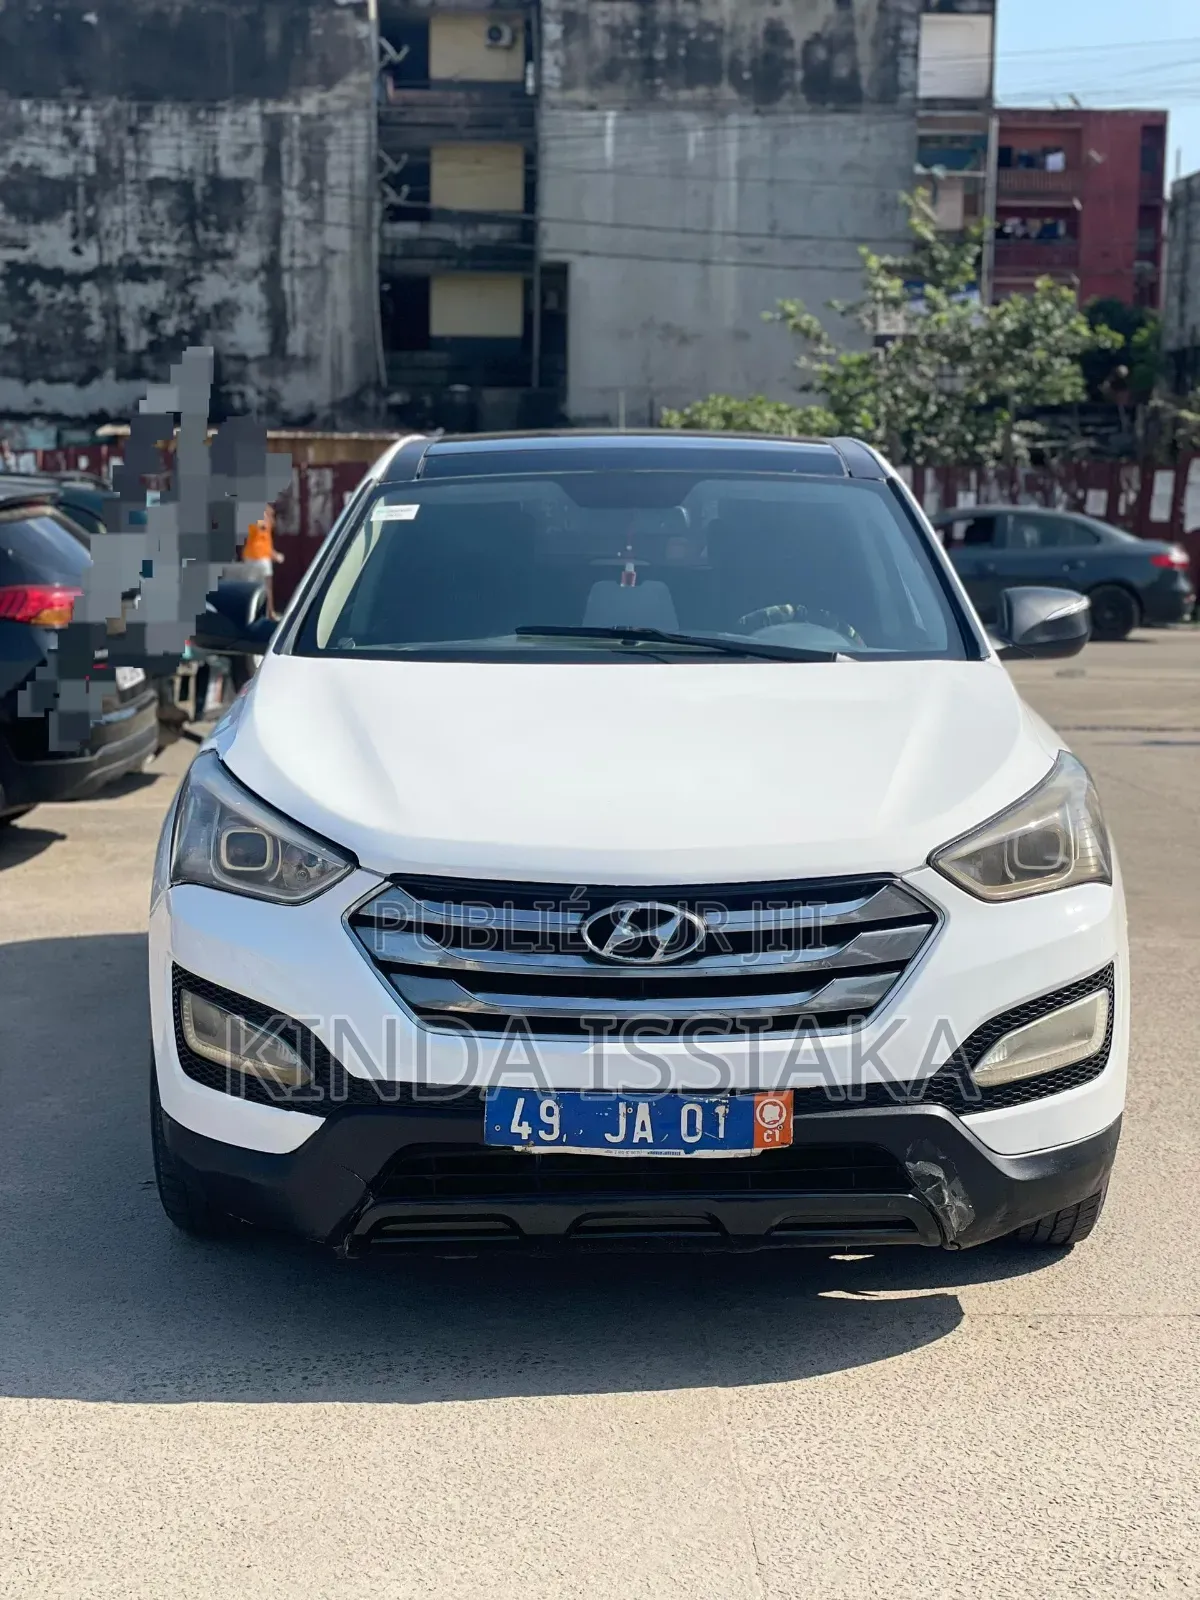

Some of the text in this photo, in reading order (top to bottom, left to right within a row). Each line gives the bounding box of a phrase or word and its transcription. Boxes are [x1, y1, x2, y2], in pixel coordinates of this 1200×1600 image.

[510, 1097, 729, 1143] 49 JA 01
